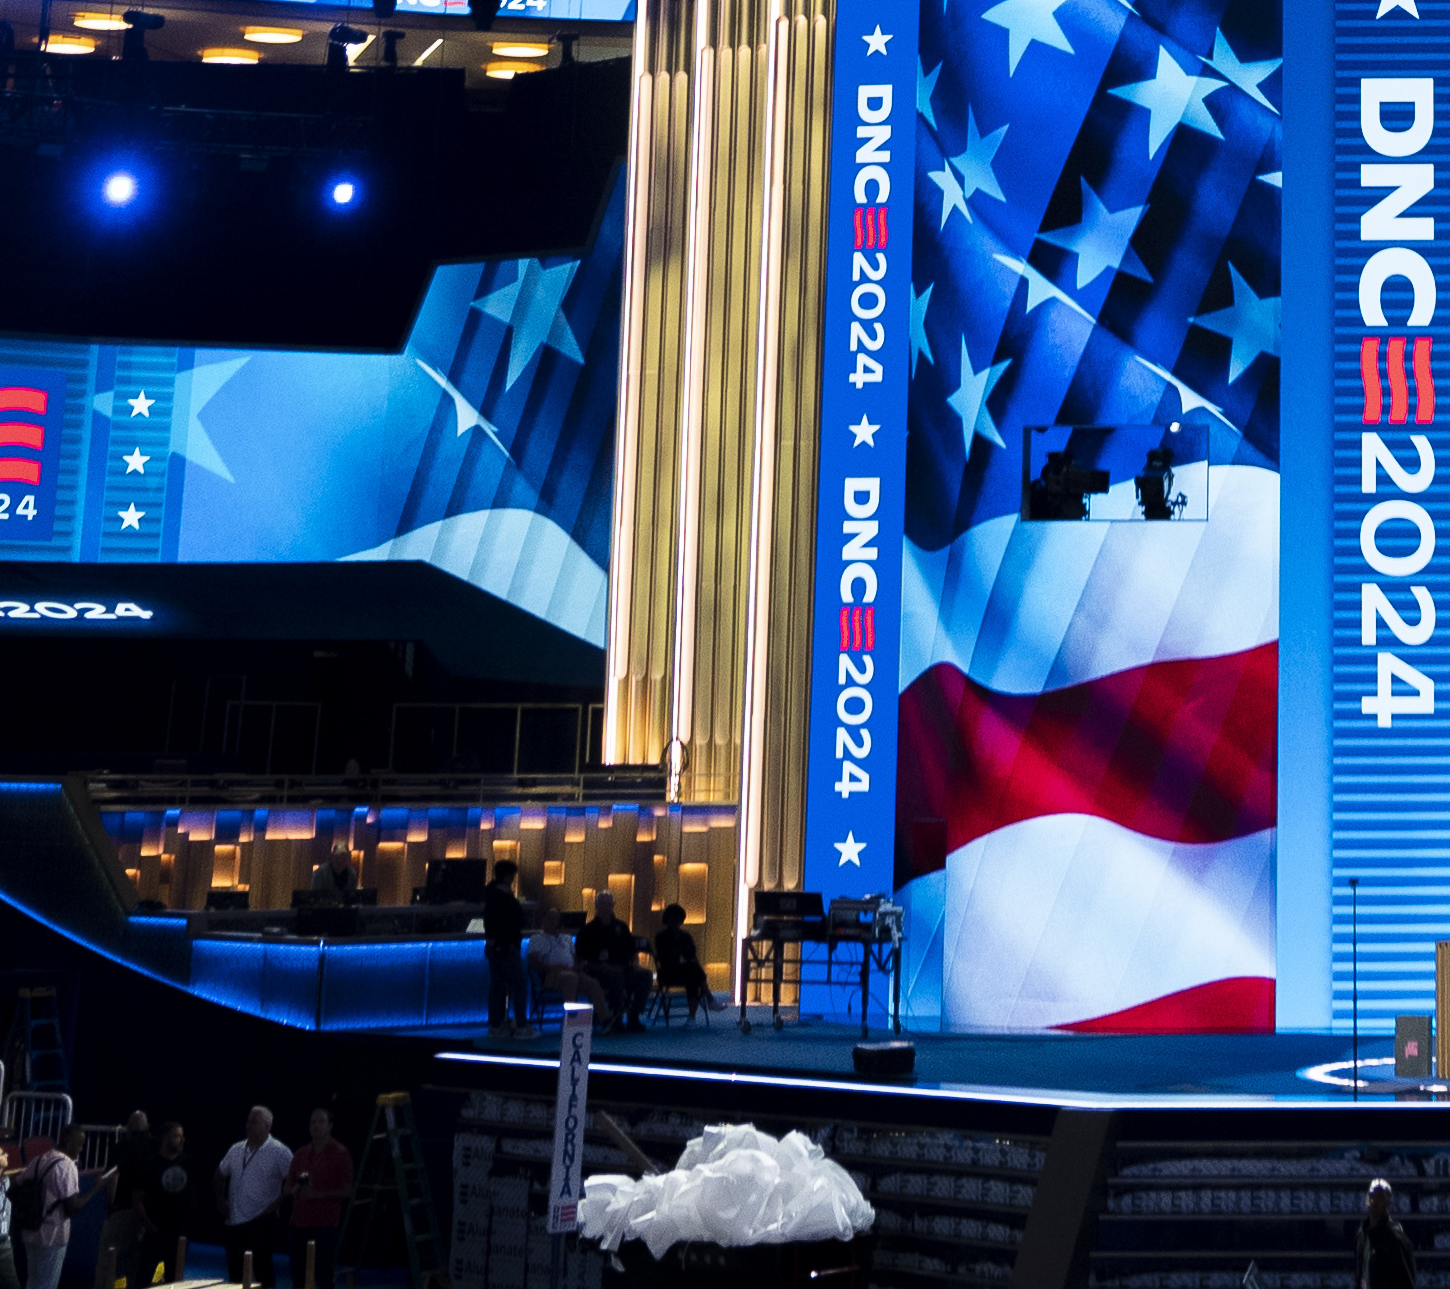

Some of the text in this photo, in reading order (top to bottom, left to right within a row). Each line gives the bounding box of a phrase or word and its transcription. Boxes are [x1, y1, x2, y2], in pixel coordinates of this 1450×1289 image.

[848, 83, 893, 390] DNC 2024
[1358, 77, 1437, 729] DNC 2024
[834, 476, 881, 800] DNC 2024
[560, 1032, 585, 1198] CALIFORNIA
